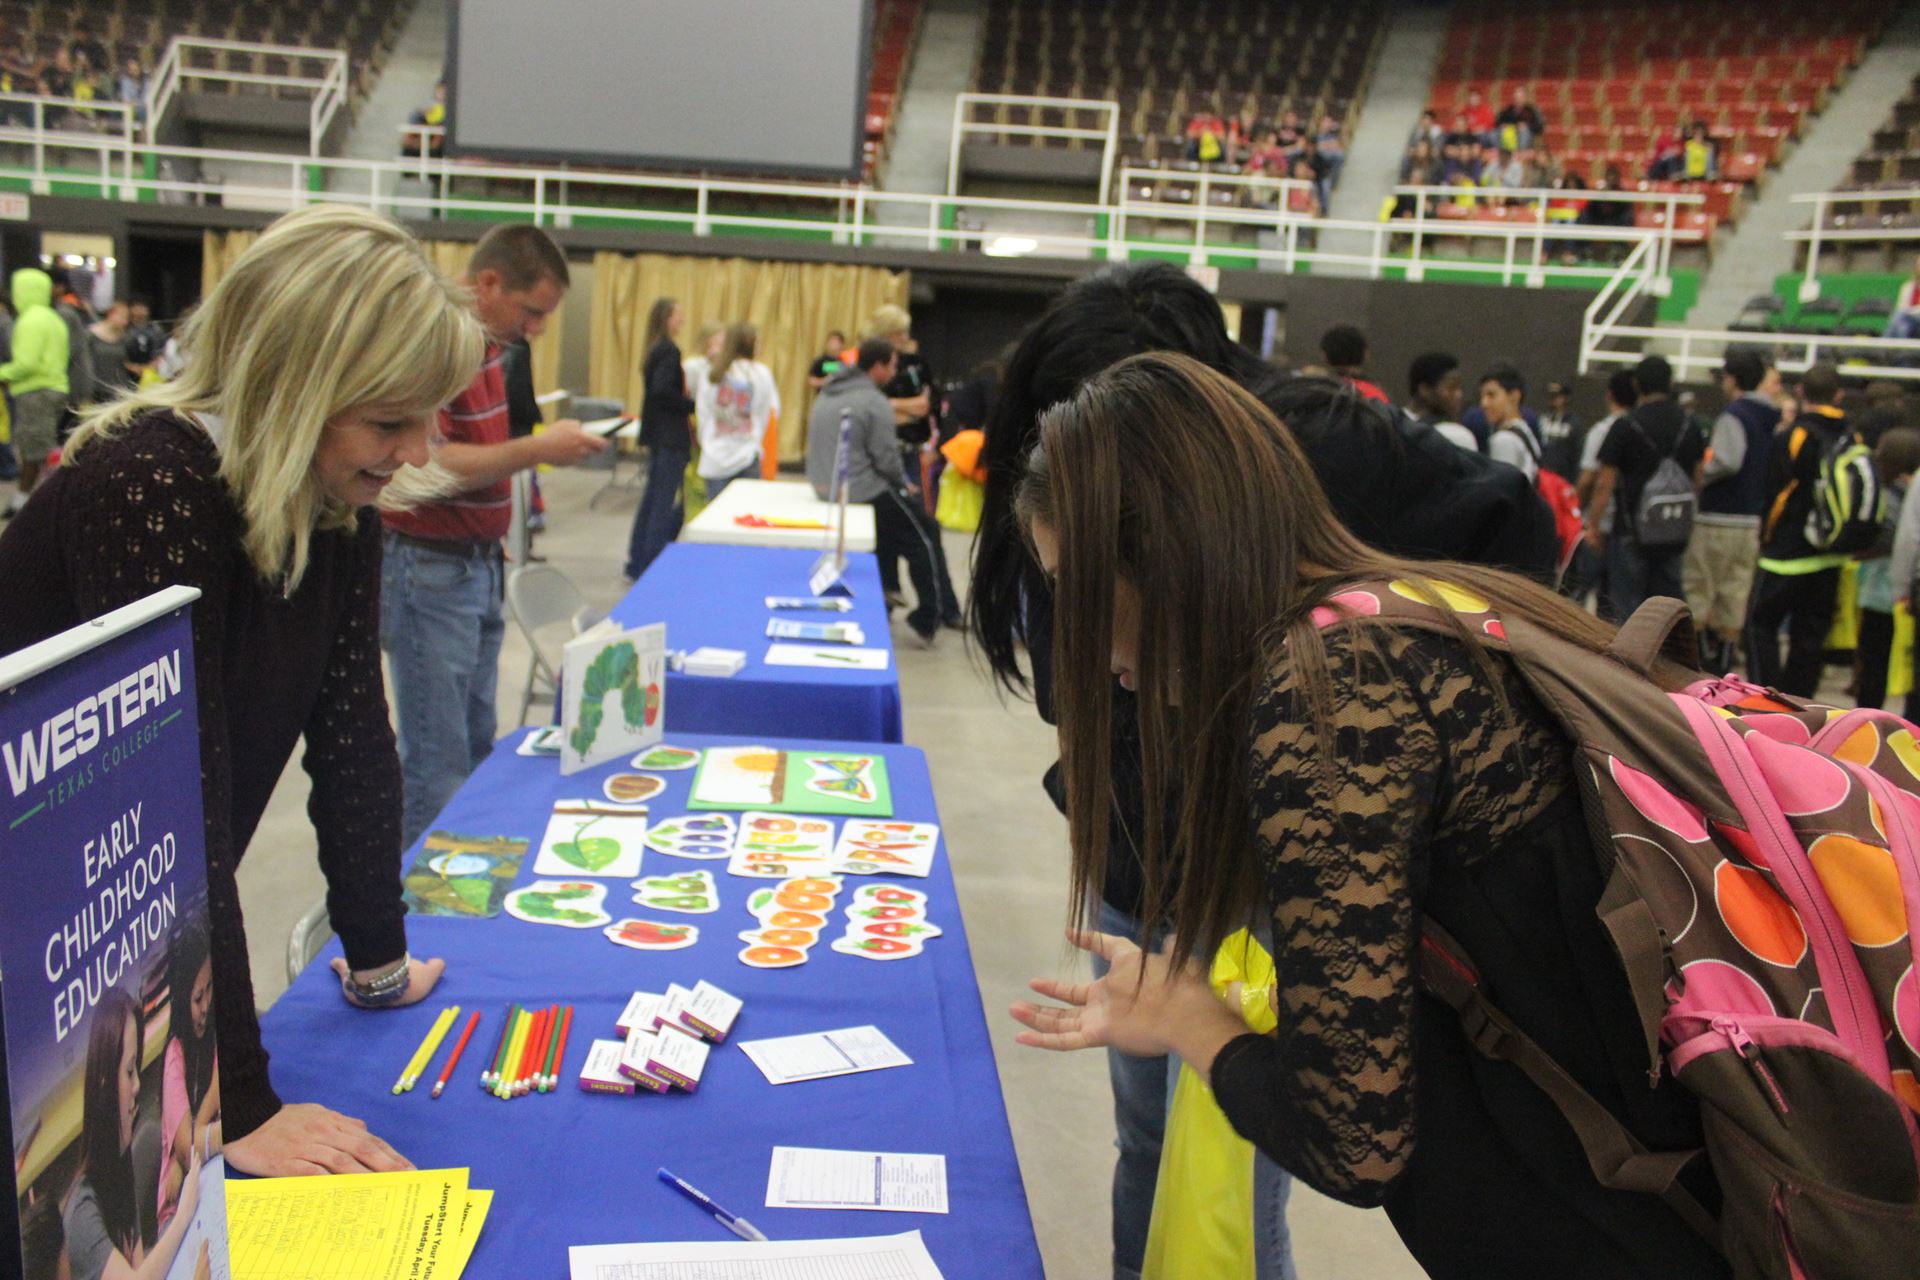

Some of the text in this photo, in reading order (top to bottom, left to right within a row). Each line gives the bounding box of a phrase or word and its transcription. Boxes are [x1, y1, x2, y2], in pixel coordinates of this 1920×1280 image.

[2, 649, 181, 797] WESTERN
[47, 719, 159, 810] TEXAS COLLEGE
[84, 801, 142, 888] EARLY
[45, 832, 176, 983] CHILDHOOD
[53, 882, 176, 1043] EDUCATION
[410, 1256, 423, 1276] April
[423, 1182, 451, 1280] JumpStart Your Futu
